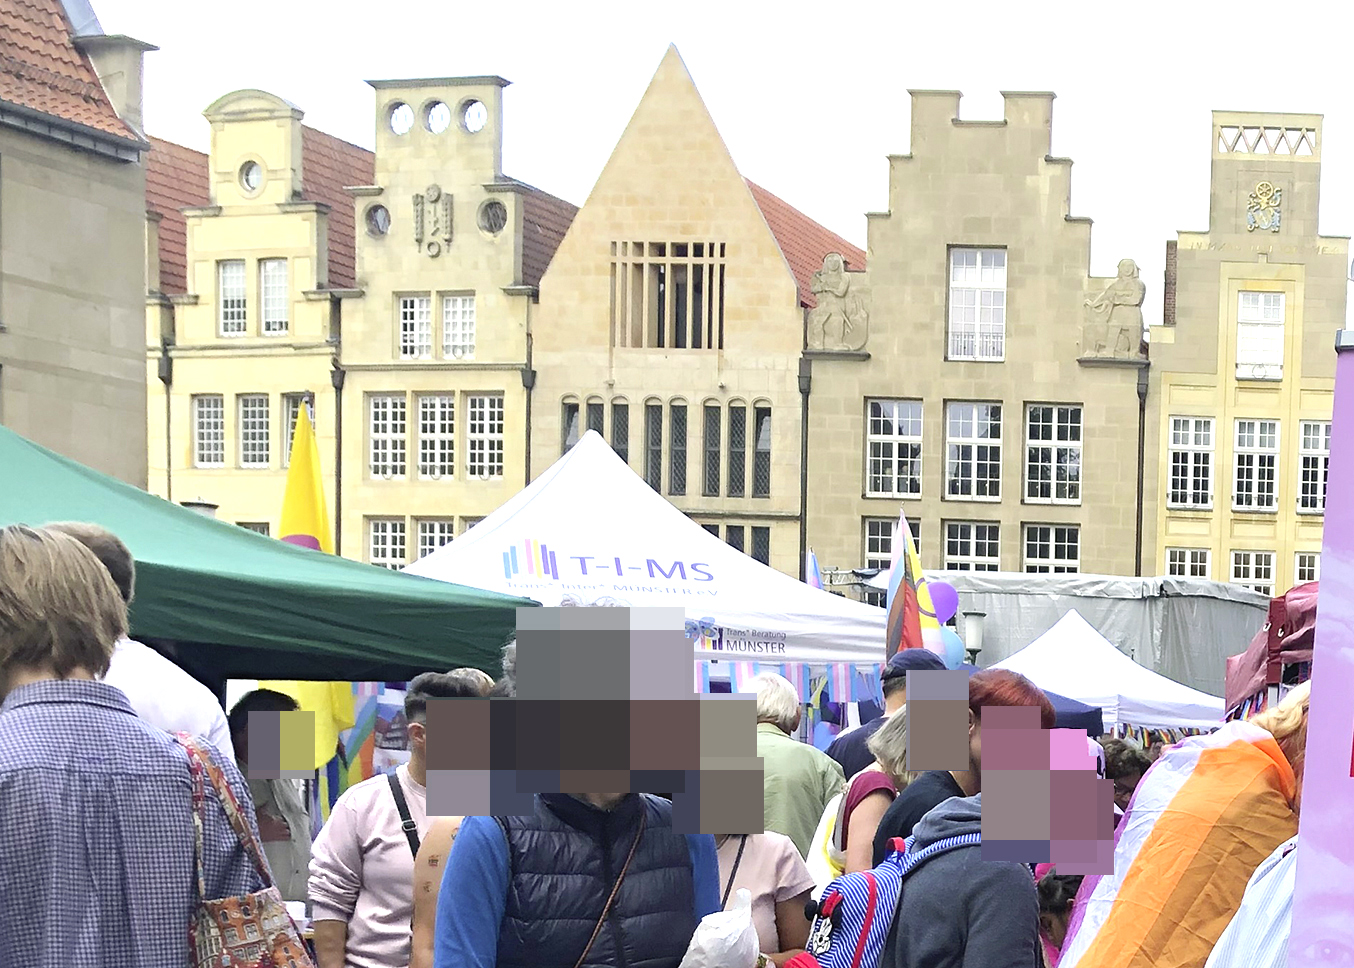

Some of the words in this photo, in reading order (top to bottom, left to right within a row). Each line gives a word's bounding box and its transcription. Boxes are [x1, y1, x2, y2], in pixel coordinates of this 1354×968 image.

[569, 556, 714, 582] T-I-MS
[751, 630, 787, 641] Beratung
[726, 638, 786, 653] MÜNSTER
